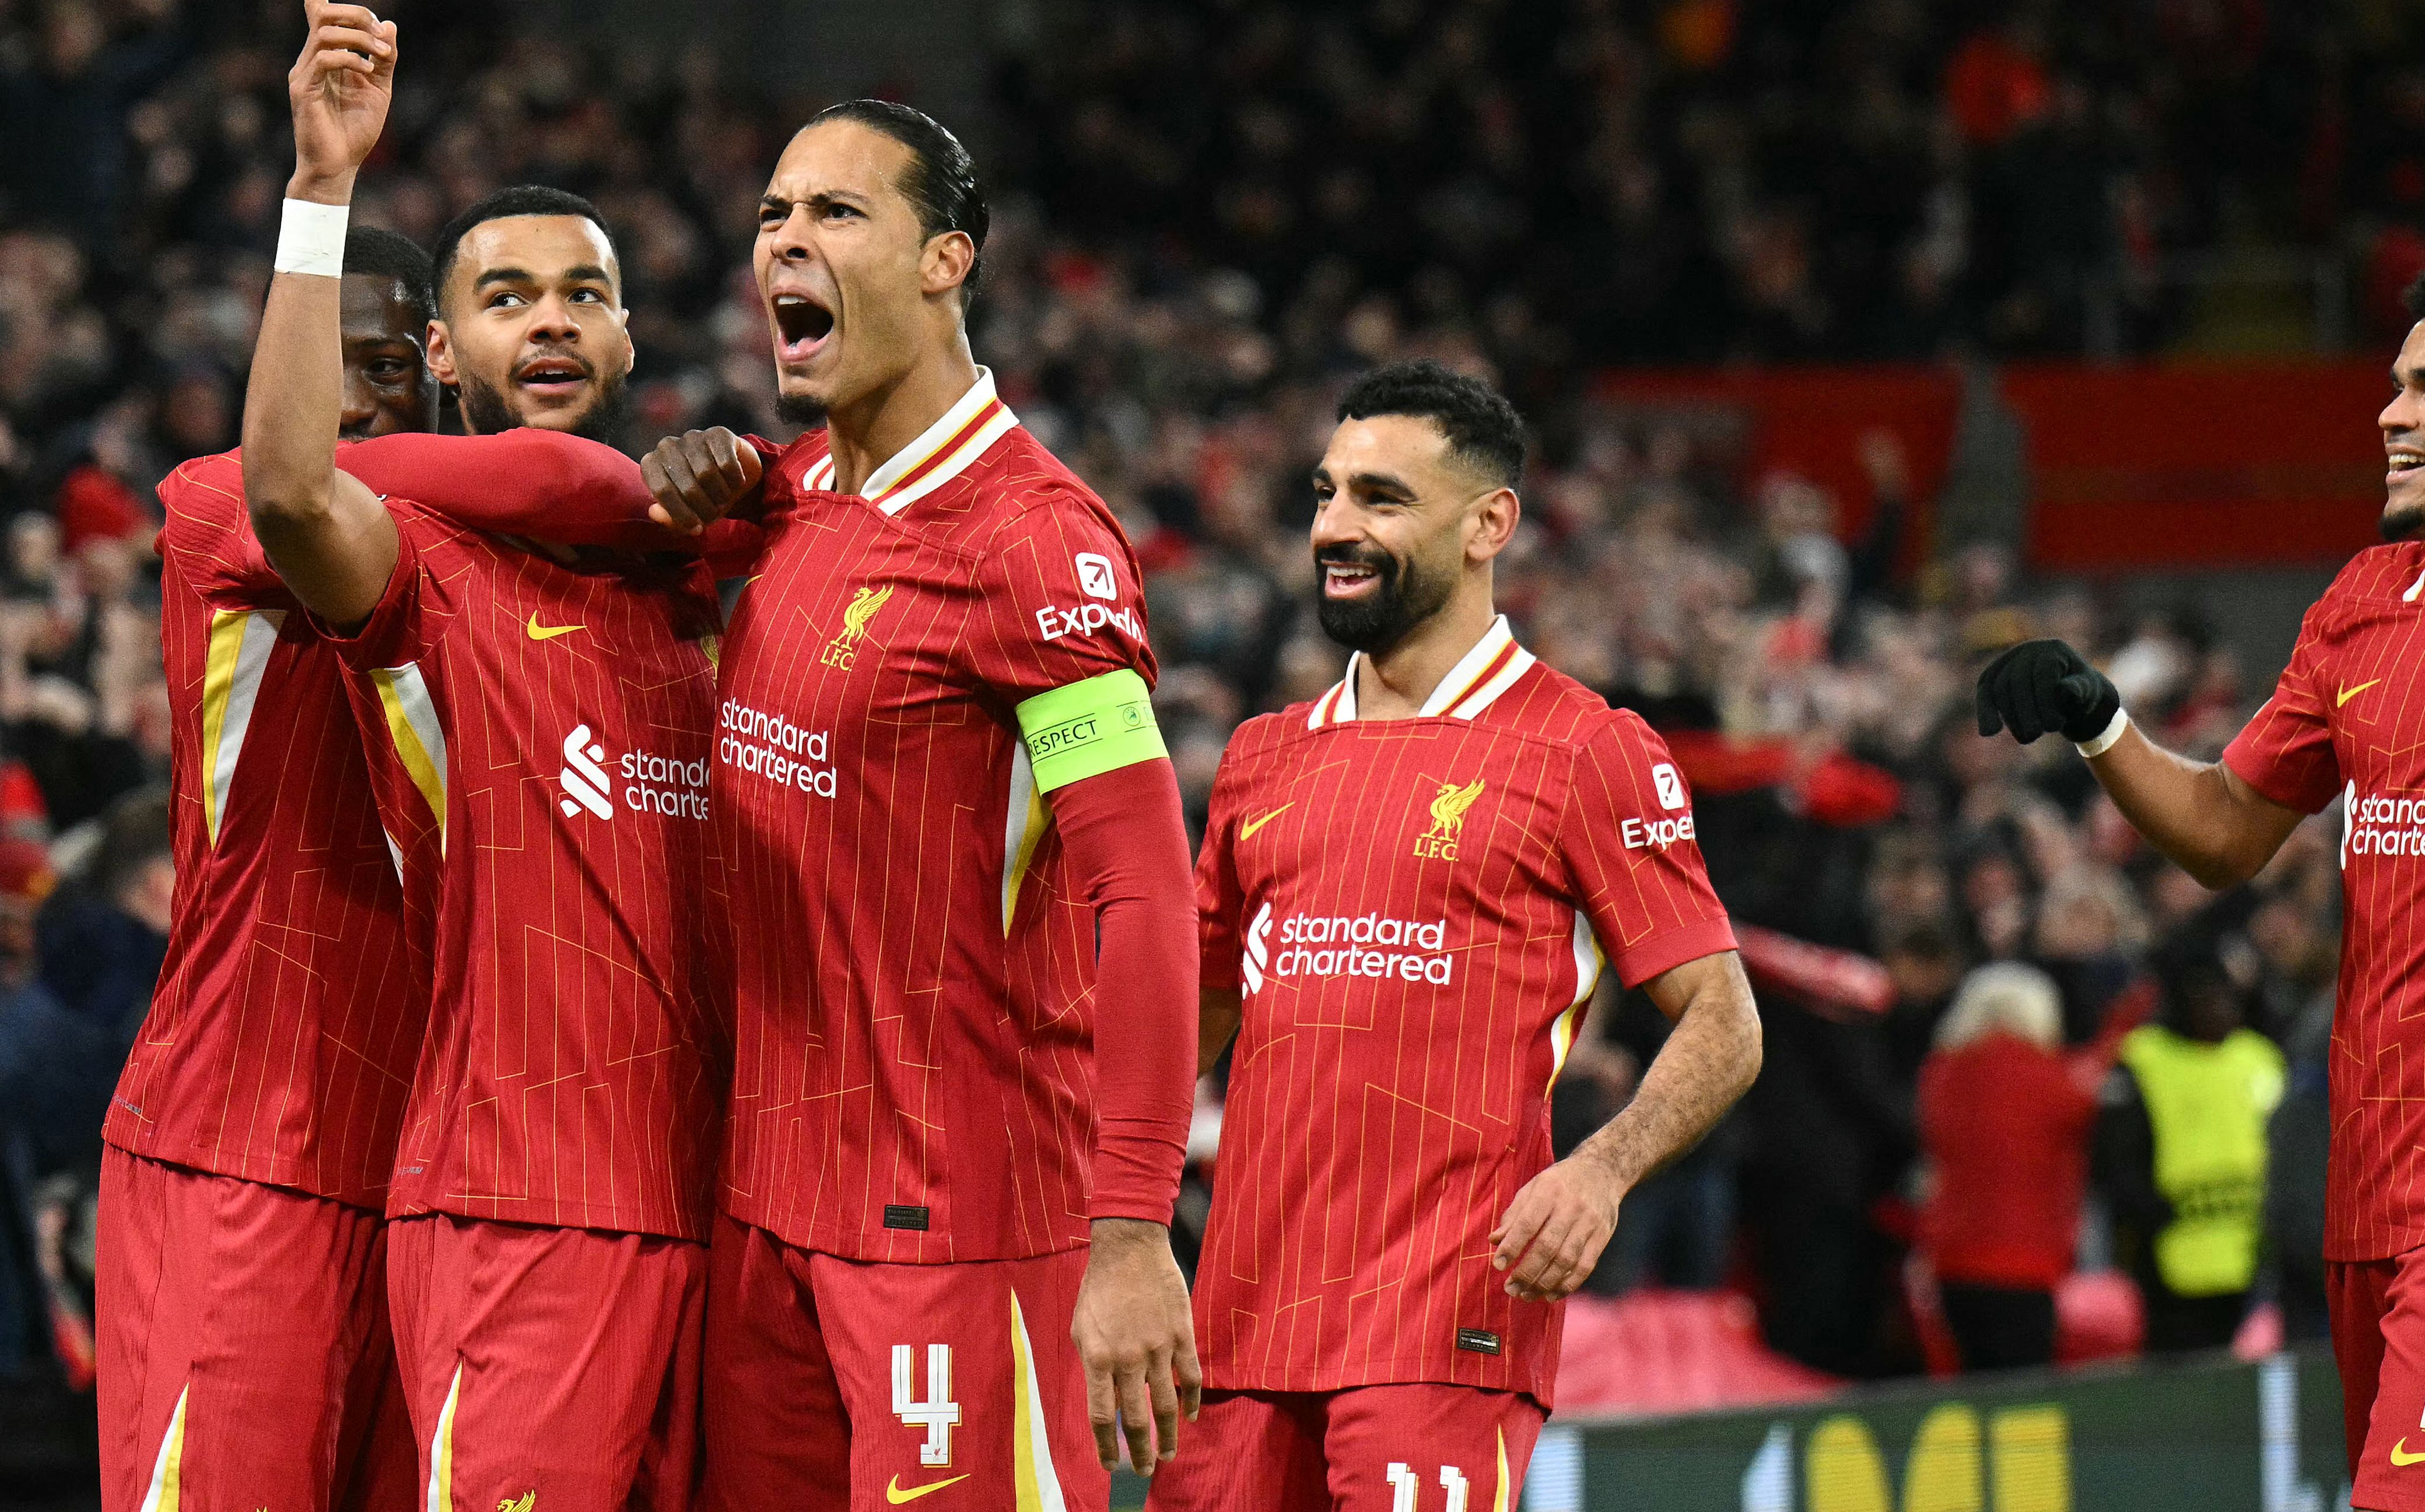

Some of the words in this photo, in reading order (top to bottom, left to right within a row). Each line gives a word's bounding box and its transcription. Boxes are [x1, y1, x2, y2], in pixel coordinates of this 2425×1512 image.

[721, 696, 828, 762] standard
[621, 748, 710, 787] stand
[720, 732, 836, 798] chartered
[2352, 823, 2425, 856] chart
[1280, 912, 1446, 950] standard
[1275, 944, 1453, 985] chartered
[892, 1343, 962, 1468] 4
